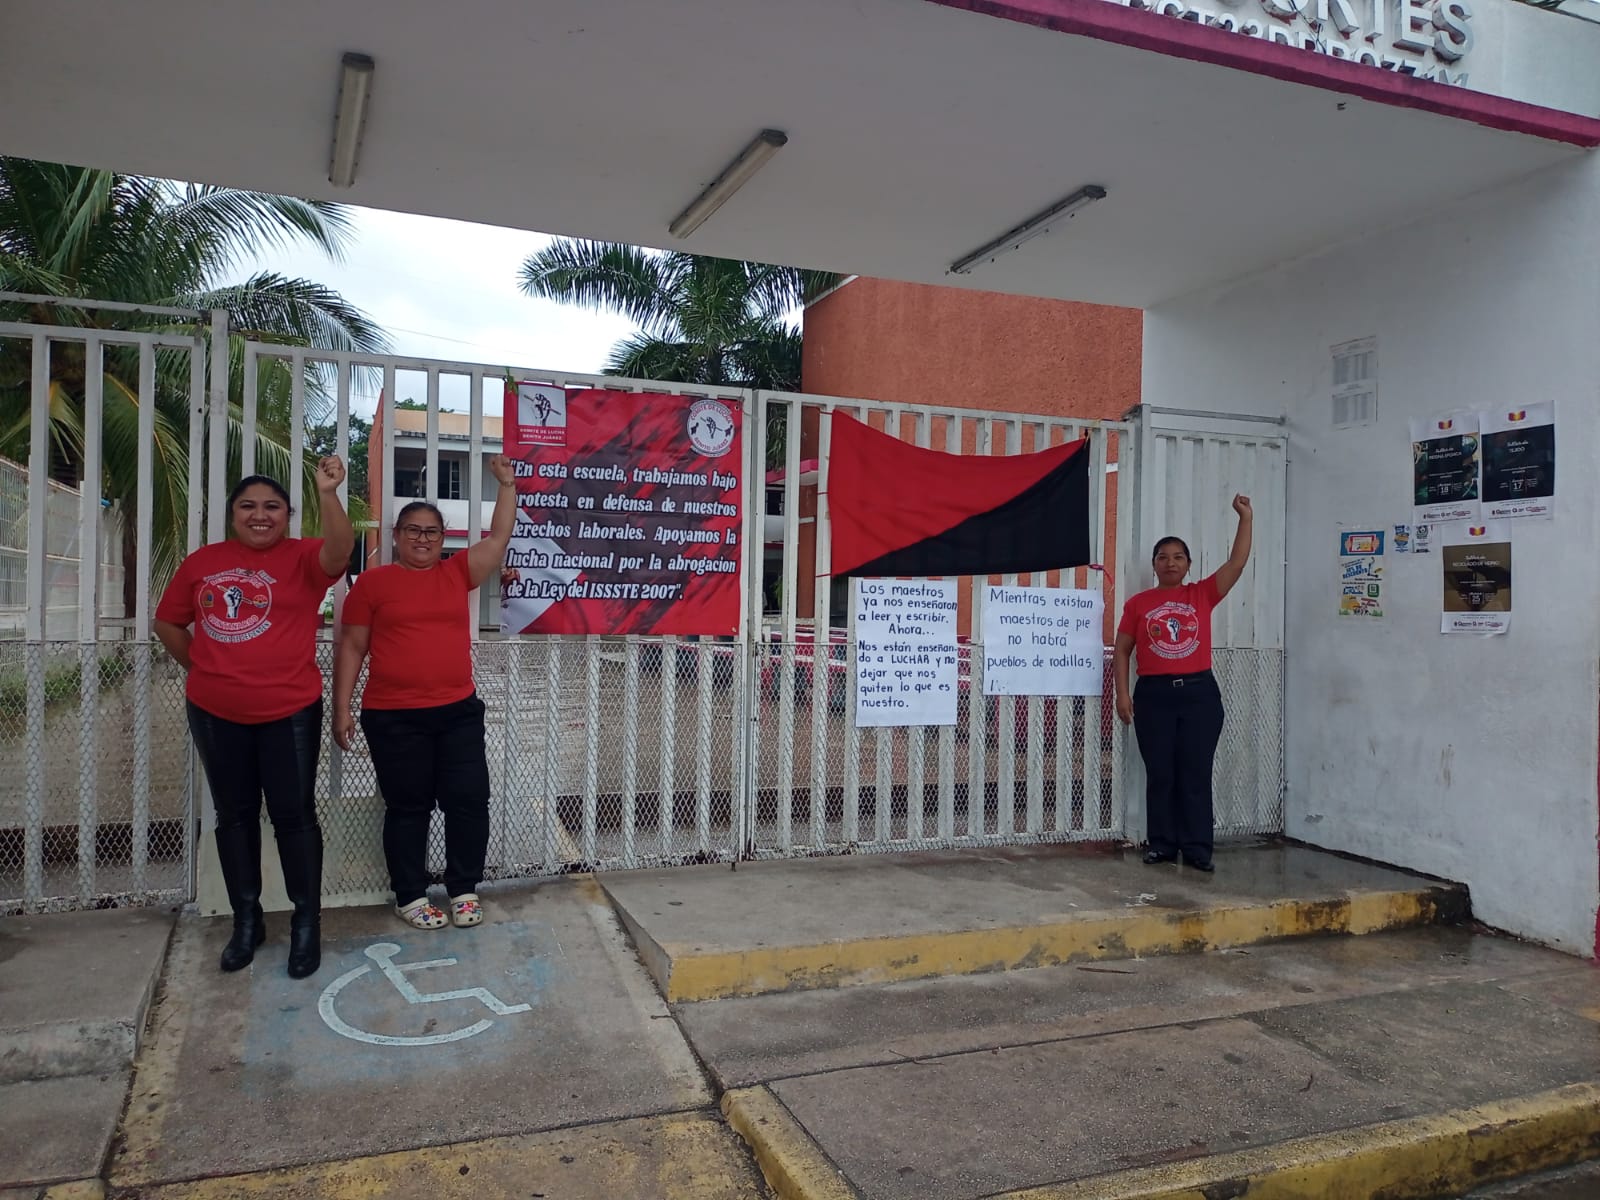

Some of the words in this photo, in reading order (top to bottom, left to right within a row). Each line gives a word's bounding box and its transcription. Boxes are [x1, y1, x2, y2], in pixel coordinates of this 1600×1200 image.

[511, 460, 533, 477] "En
[539, 462, 567, 478] esta
[574, 464, 627, 484] escuela,
[633, 468, 707, 487] trabajamos
[712, 471, 737, 491] bajo
[515, 493, 568, 509] rotesta
[577, 496, 594, 508] en
[603, 494, 653, 512] defensa
[662, 497, 676, 513] de
[684, 499, 737, 516] nuestros
[578, 522, 646, 540] laborales.
[654, 526, 720, 545] Apoyamos
[726, 529, 736, 545] la
[507, 549, 548, 567] lucha
[553, 551, 613, 569] nacional
[618, 556, 643, 572] por
[649, 553, 661, 570] la
[668, 555, 736, 575] abrogacion
[507, 581, 524, 597] de
[525, 581, 539, 598] la
[541, 582, 566, 601] Ley
[568, 582, 589, 598] del
[590, 583, 640, 599] ISSSTE
[641, 583, 683, 599] 2007".
[860, 583, 885, 595] Los
[892, 584, 944, 598] maestros
[884, 599, 903, 607] nos
[907, 600, 958, 611] enseñaron
[990, 589, 1046, 606] Mientras
[1054, 595, 1093, 609] existan
[858, 613, 866, 621] a
[871, 611, 890, 621] leer
[896, 613, 901, 624] y
[906, 612, 949, 624] escribir.
[1000, 614, 1053, 626] maestros
[1057, 616, 1069, 628] de
[1076, 618, 1090, 631] pie
[889, 623, 934, 635] Ahora...
[859, 640, 877, 651] Nos
[884, 641, 911, 652] están
[1008, 635, 1022, 645] no
[1032, 633, 1068, 646] habrá
[859, 653, 871, 663] do
[891, 654, 930, 664] LUCHAR
[936, 658, 941, 668] y
[944, 655, 956, 664] no
[987, 656, 1027, 671] pueblos
[1032, 658, 1044, 667] de
[1050, 656, 1096, 670] rodillas.
[860, 668, 887, 681] dejar
[894, 671, 913, 681] que
[918, 670, 936, 678] nos
[860, 683, 893, 695] quiten
[900, 682, 910, 692] lo
[915, 684, 932, 693] que
[939, 683, 950, 692] es
[861, 697, 909, 708] nuestro.
